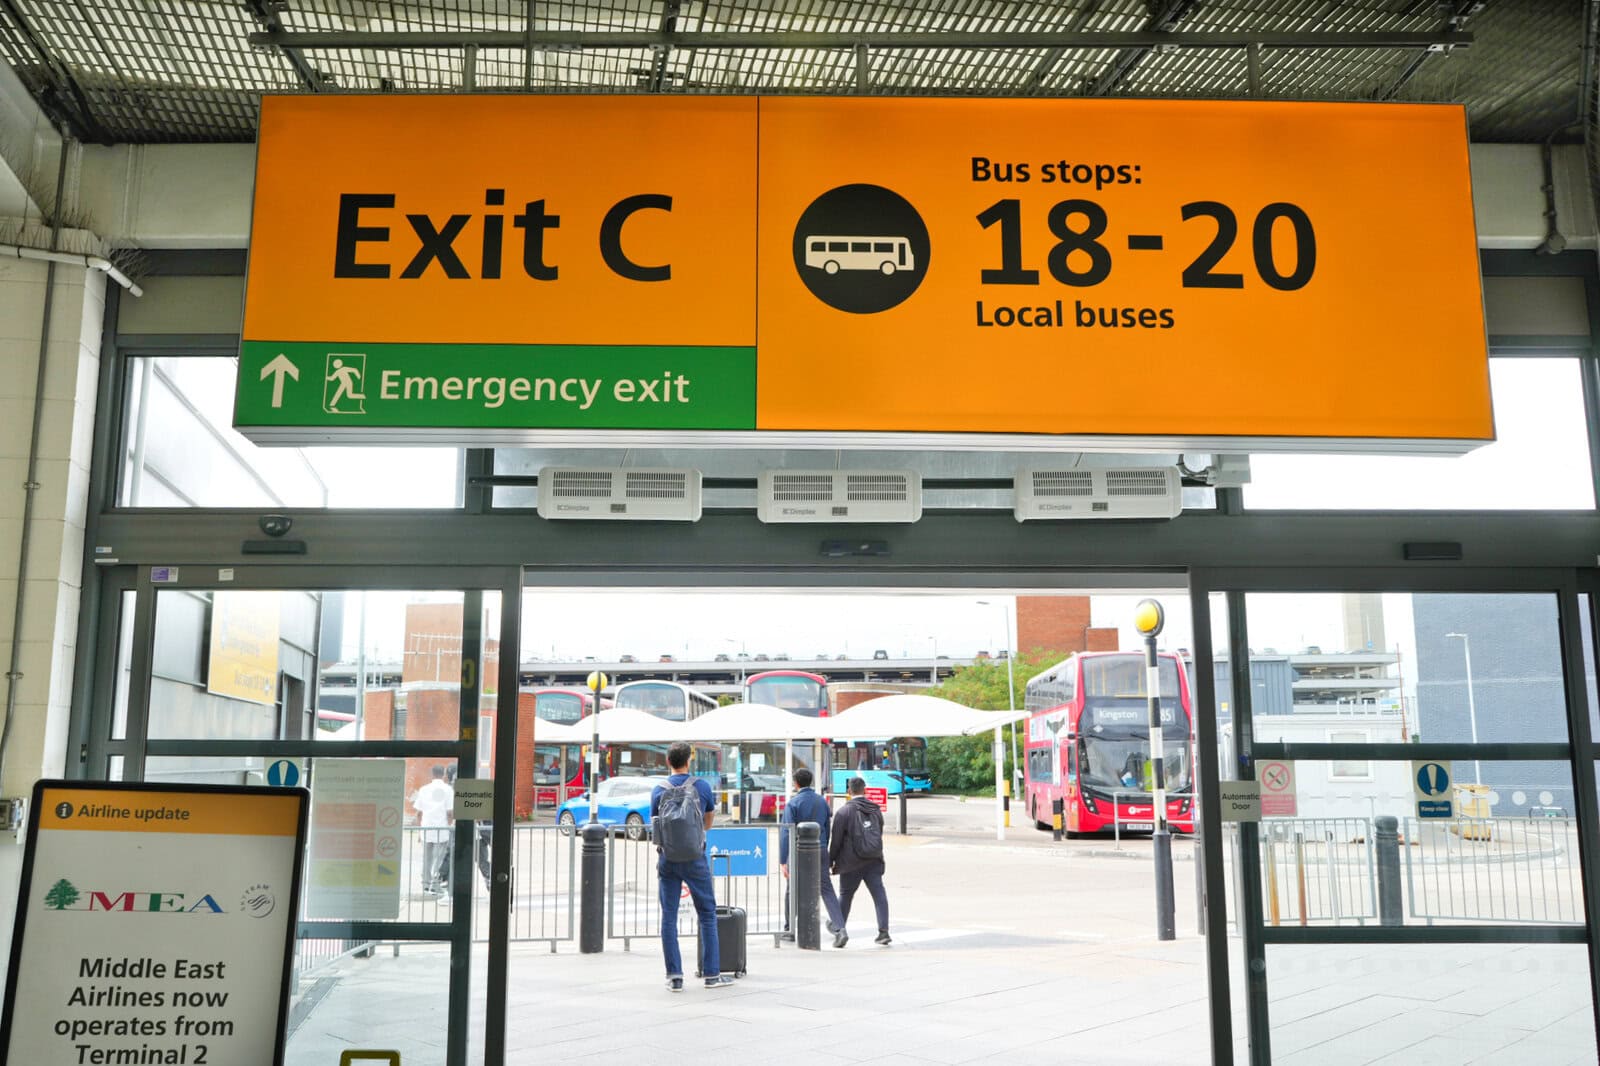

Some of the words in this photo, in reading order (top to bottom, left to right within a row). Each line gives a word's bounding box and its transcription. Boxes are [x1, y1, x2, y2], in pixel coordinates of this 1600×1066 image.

[971, 156, 1031, 183] Bus
[1040, 159, 1142, 191] stops:
[333, 188, 561, 281] Exit
[599, 193, 673, 282] C
[975, 198, 1317, 292] 18-20
[976, 299, 1063, 328] Local
[1075, 300, 1175, 329] buses
[380, 370, 601, 409] Emergency
[613, 371, 690, 403] exit
[1100, 710, 1138, 720] Kingston
[455, 791, 492, 799] Automatic
[1232, 802, 1251, 810] Door
[78, 804, 131, 819] Airline
[134, 806, 191, 823] update
[86, 891, 227, 914] MEA
[79, 957, 167, 979] Middle
[173, 959, 226, 980] East
[67, 985, 165, 1007] Airlines
[172, 991, 229, 1008] now
[54, 1016, 167, 1041] operates
[174, 1014, 234, 1036] from
[75, 1043, 187, 1065] Terminal
[193, 1044, 208, 1065] 2
